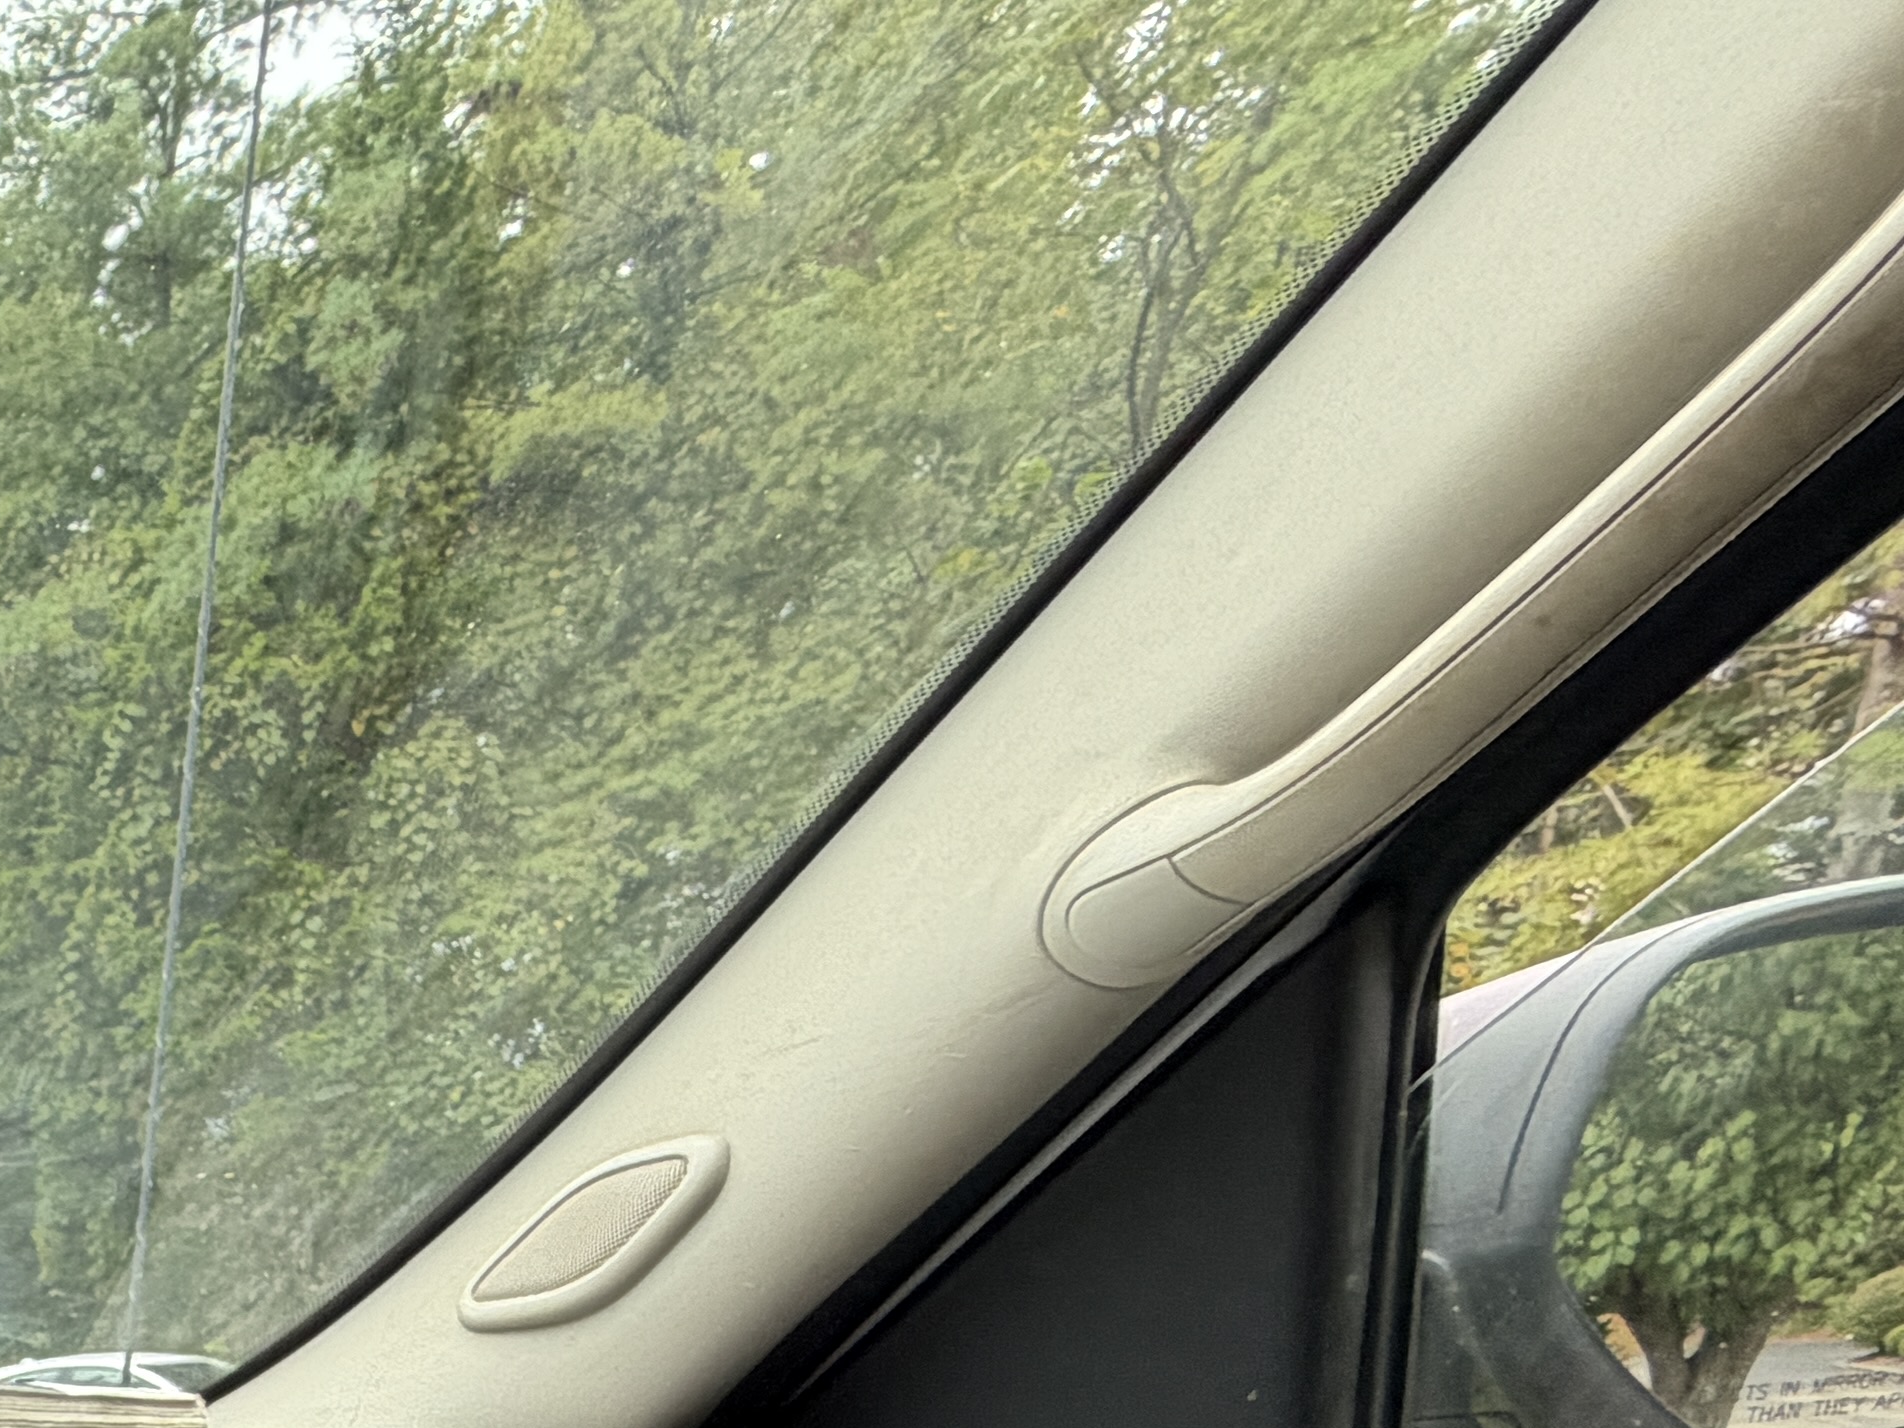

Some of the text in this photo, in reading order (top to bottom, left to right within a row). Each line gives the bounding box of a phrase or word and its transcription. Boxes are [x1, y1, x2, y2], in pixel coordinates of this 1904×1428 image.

[1780, 1380, 1802, 1397] IN
[1812, 1371, 1890, 1393] MIRROR
[1747, 1402, 1804, 1423] THAN
[1814, 1395, 1870, 1417] THEY
